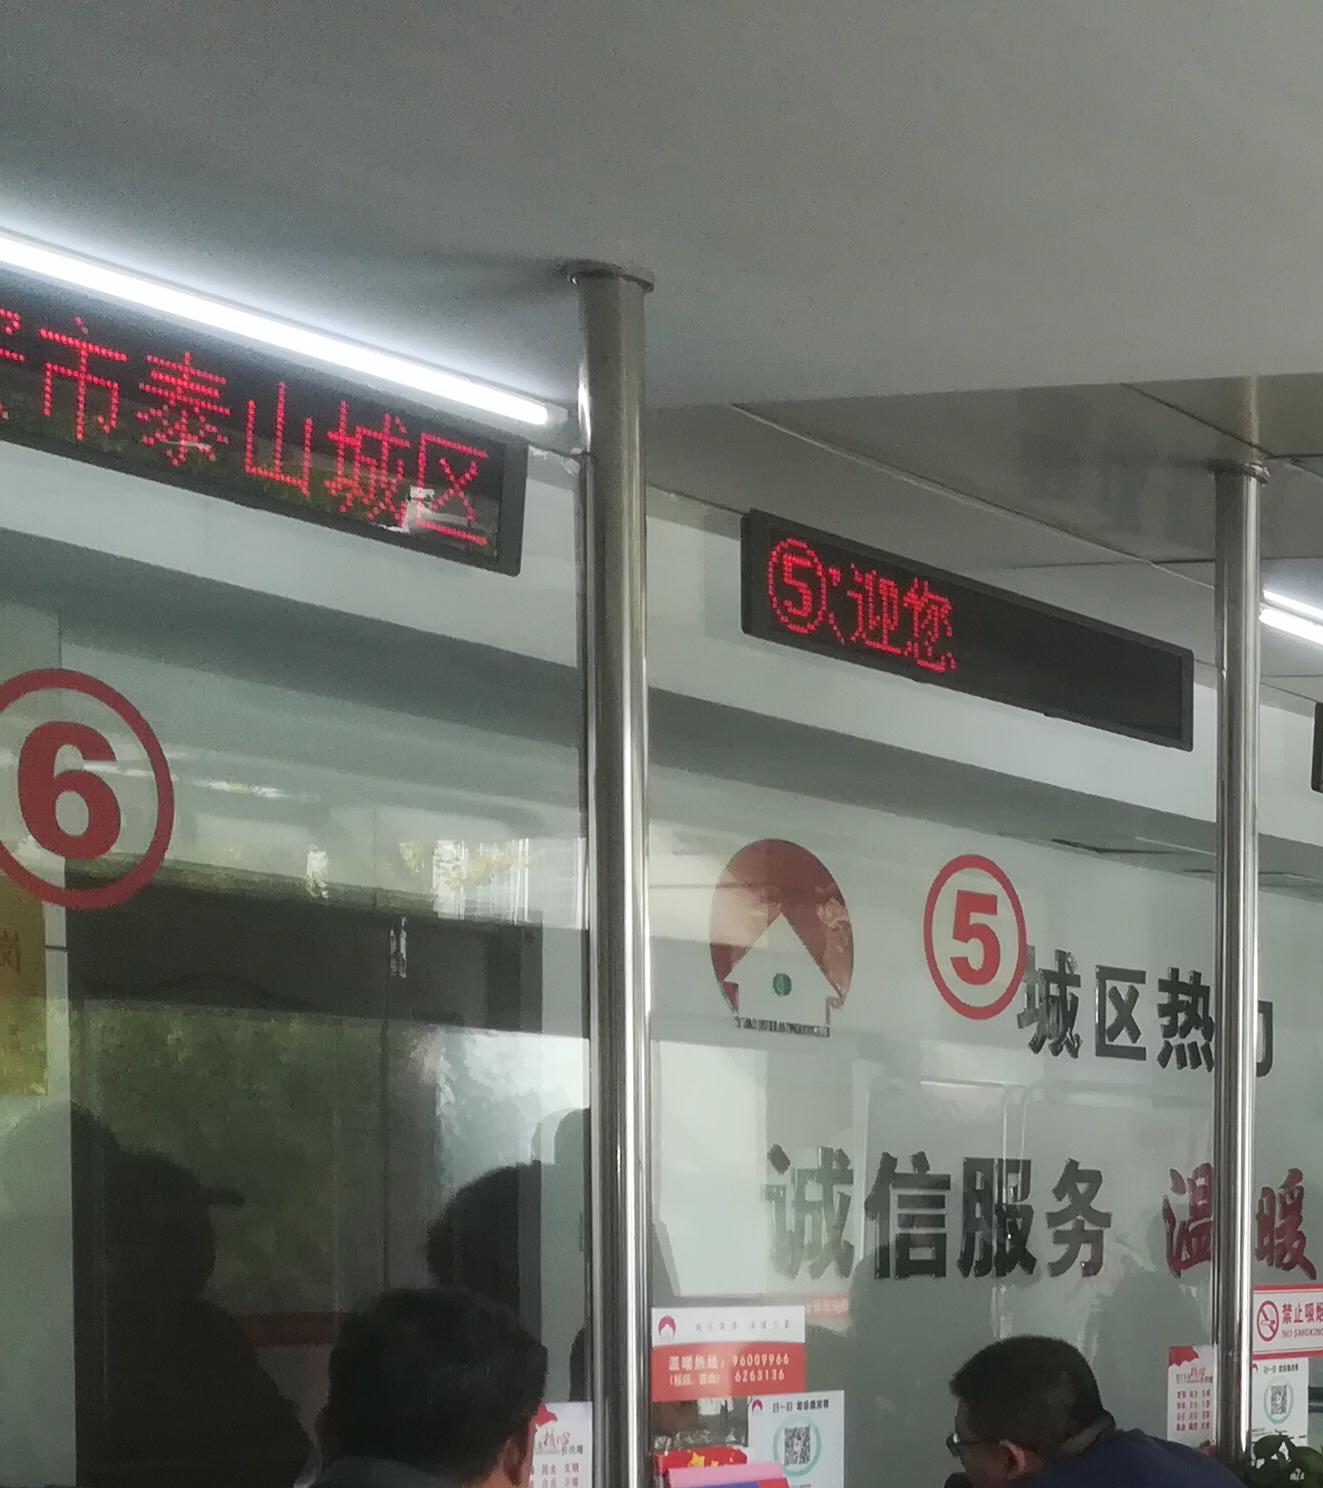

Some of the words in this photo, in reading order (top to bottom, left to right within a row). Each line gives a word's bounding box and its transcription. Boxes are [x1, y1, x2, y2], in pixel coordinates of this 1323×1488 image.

[0, 308, 488, 546] 市泰山城区
[766, 1143, 1112, 1281] 诚信服务
